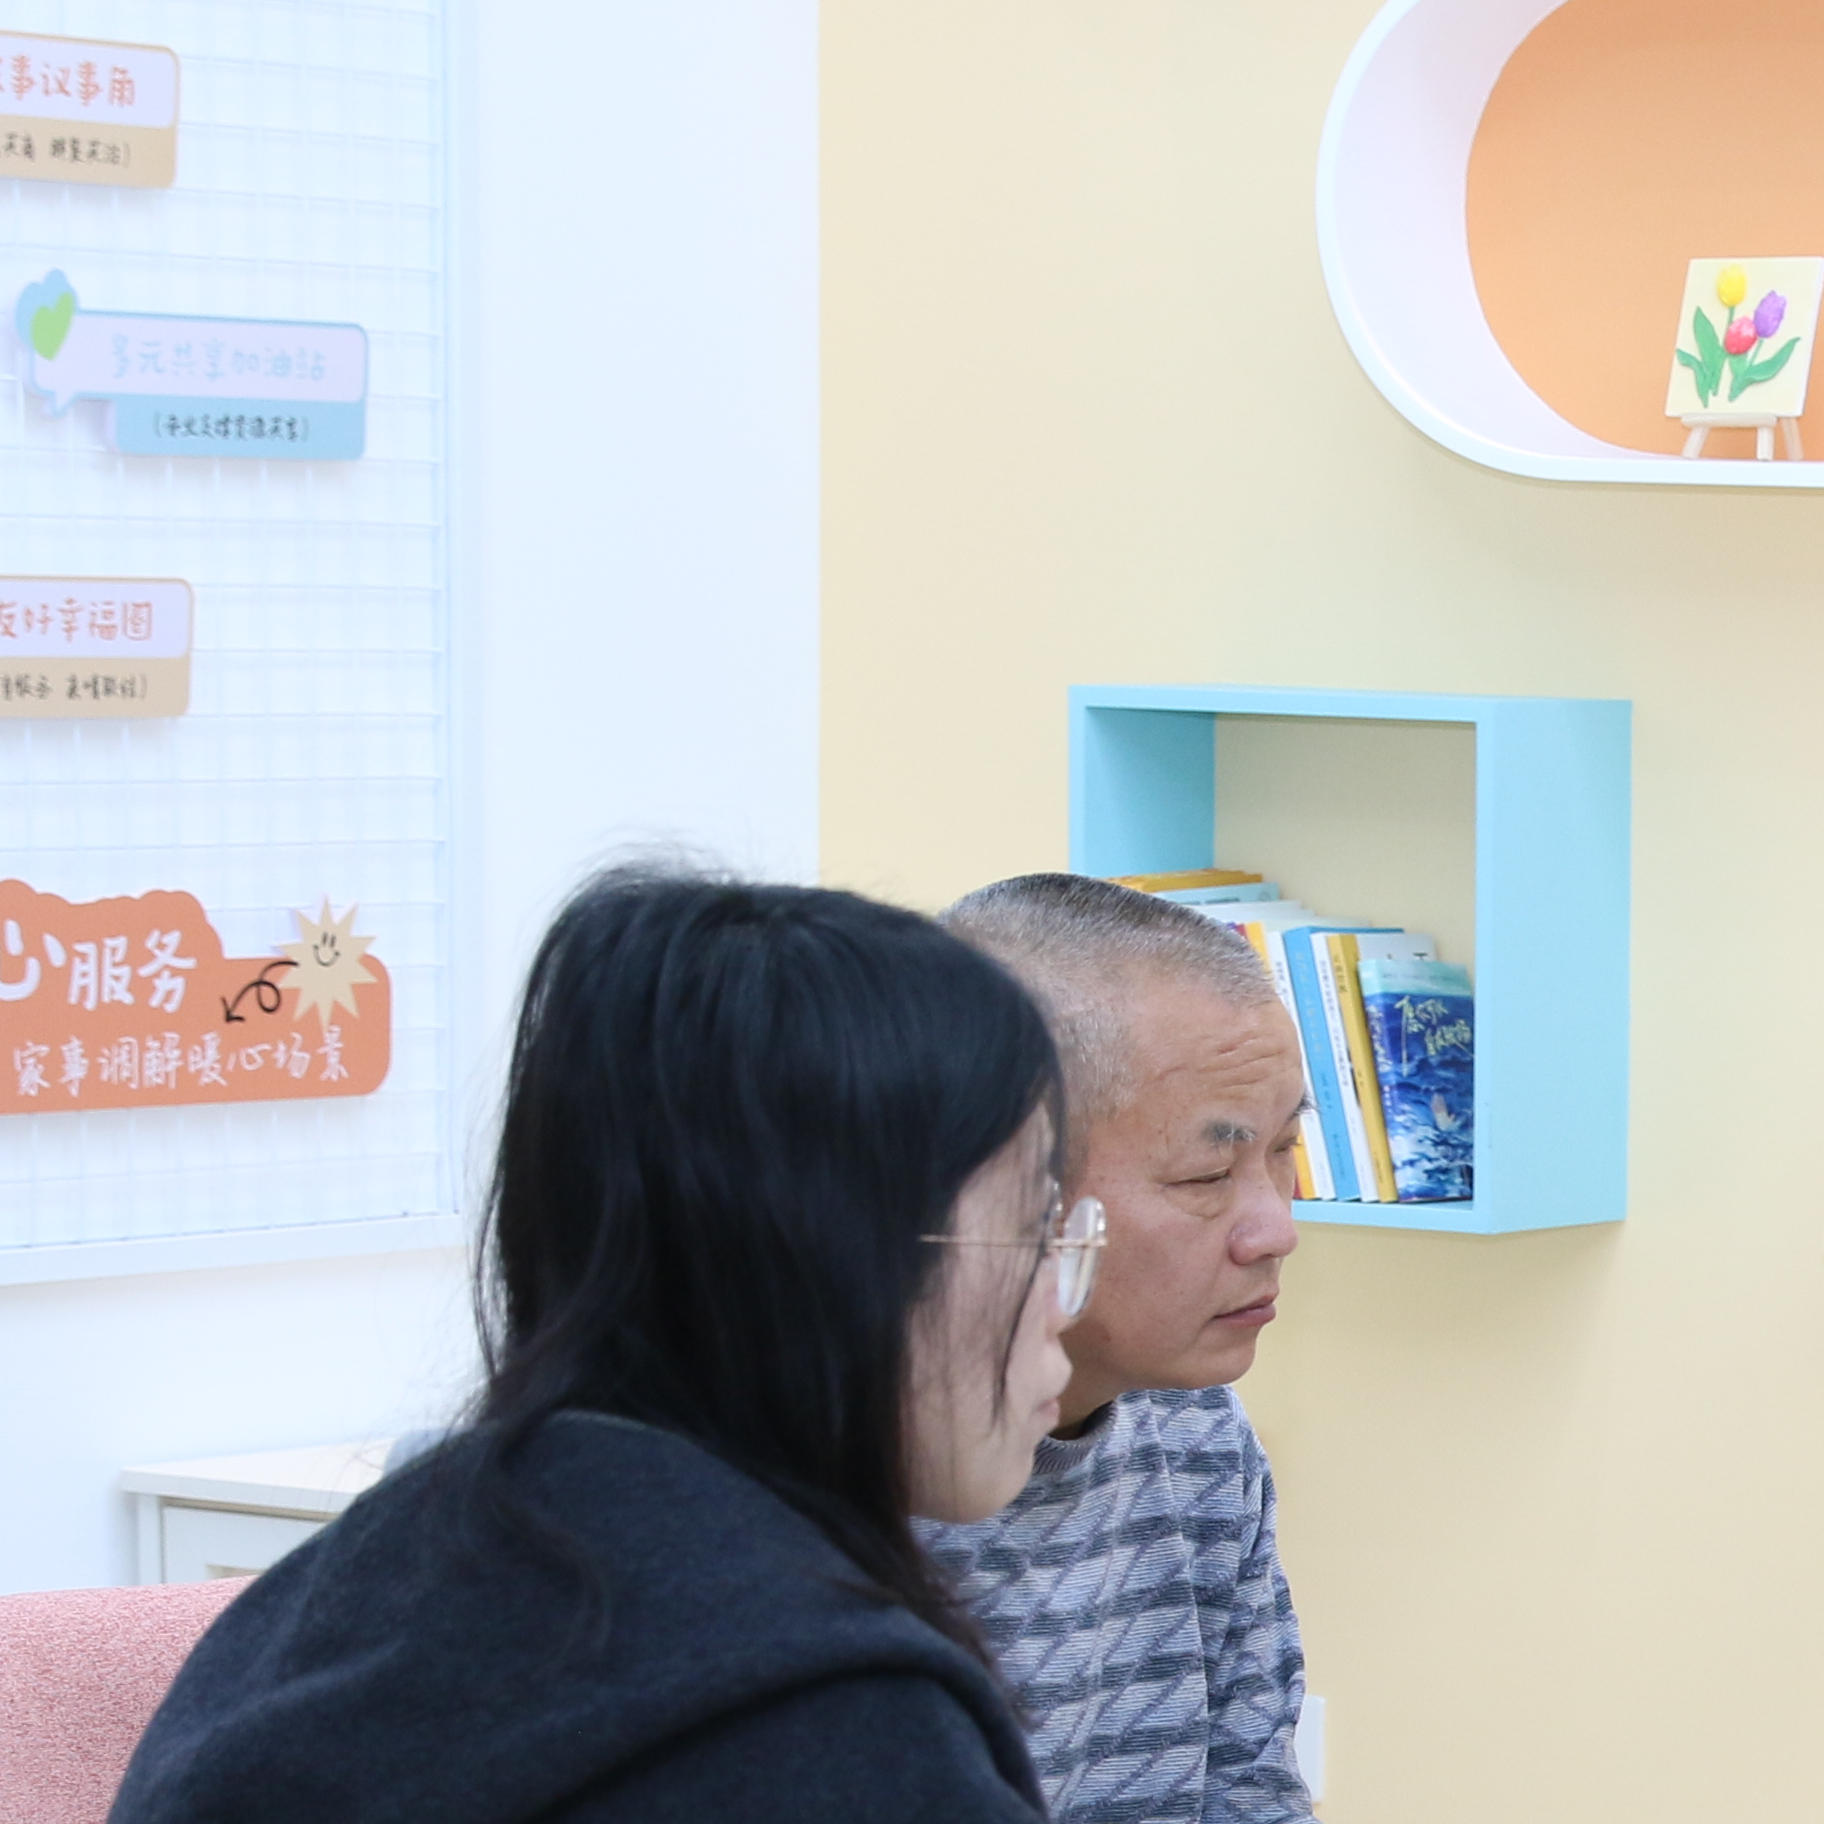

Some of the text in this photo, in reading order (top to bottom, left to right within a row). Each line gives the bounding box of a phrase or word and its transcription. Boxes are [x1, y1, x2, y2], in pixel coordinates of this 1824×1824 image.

[0, 54, 136, 107] 事议事角
[12, 1025, 349, 1098] 家事调解暖心场景
